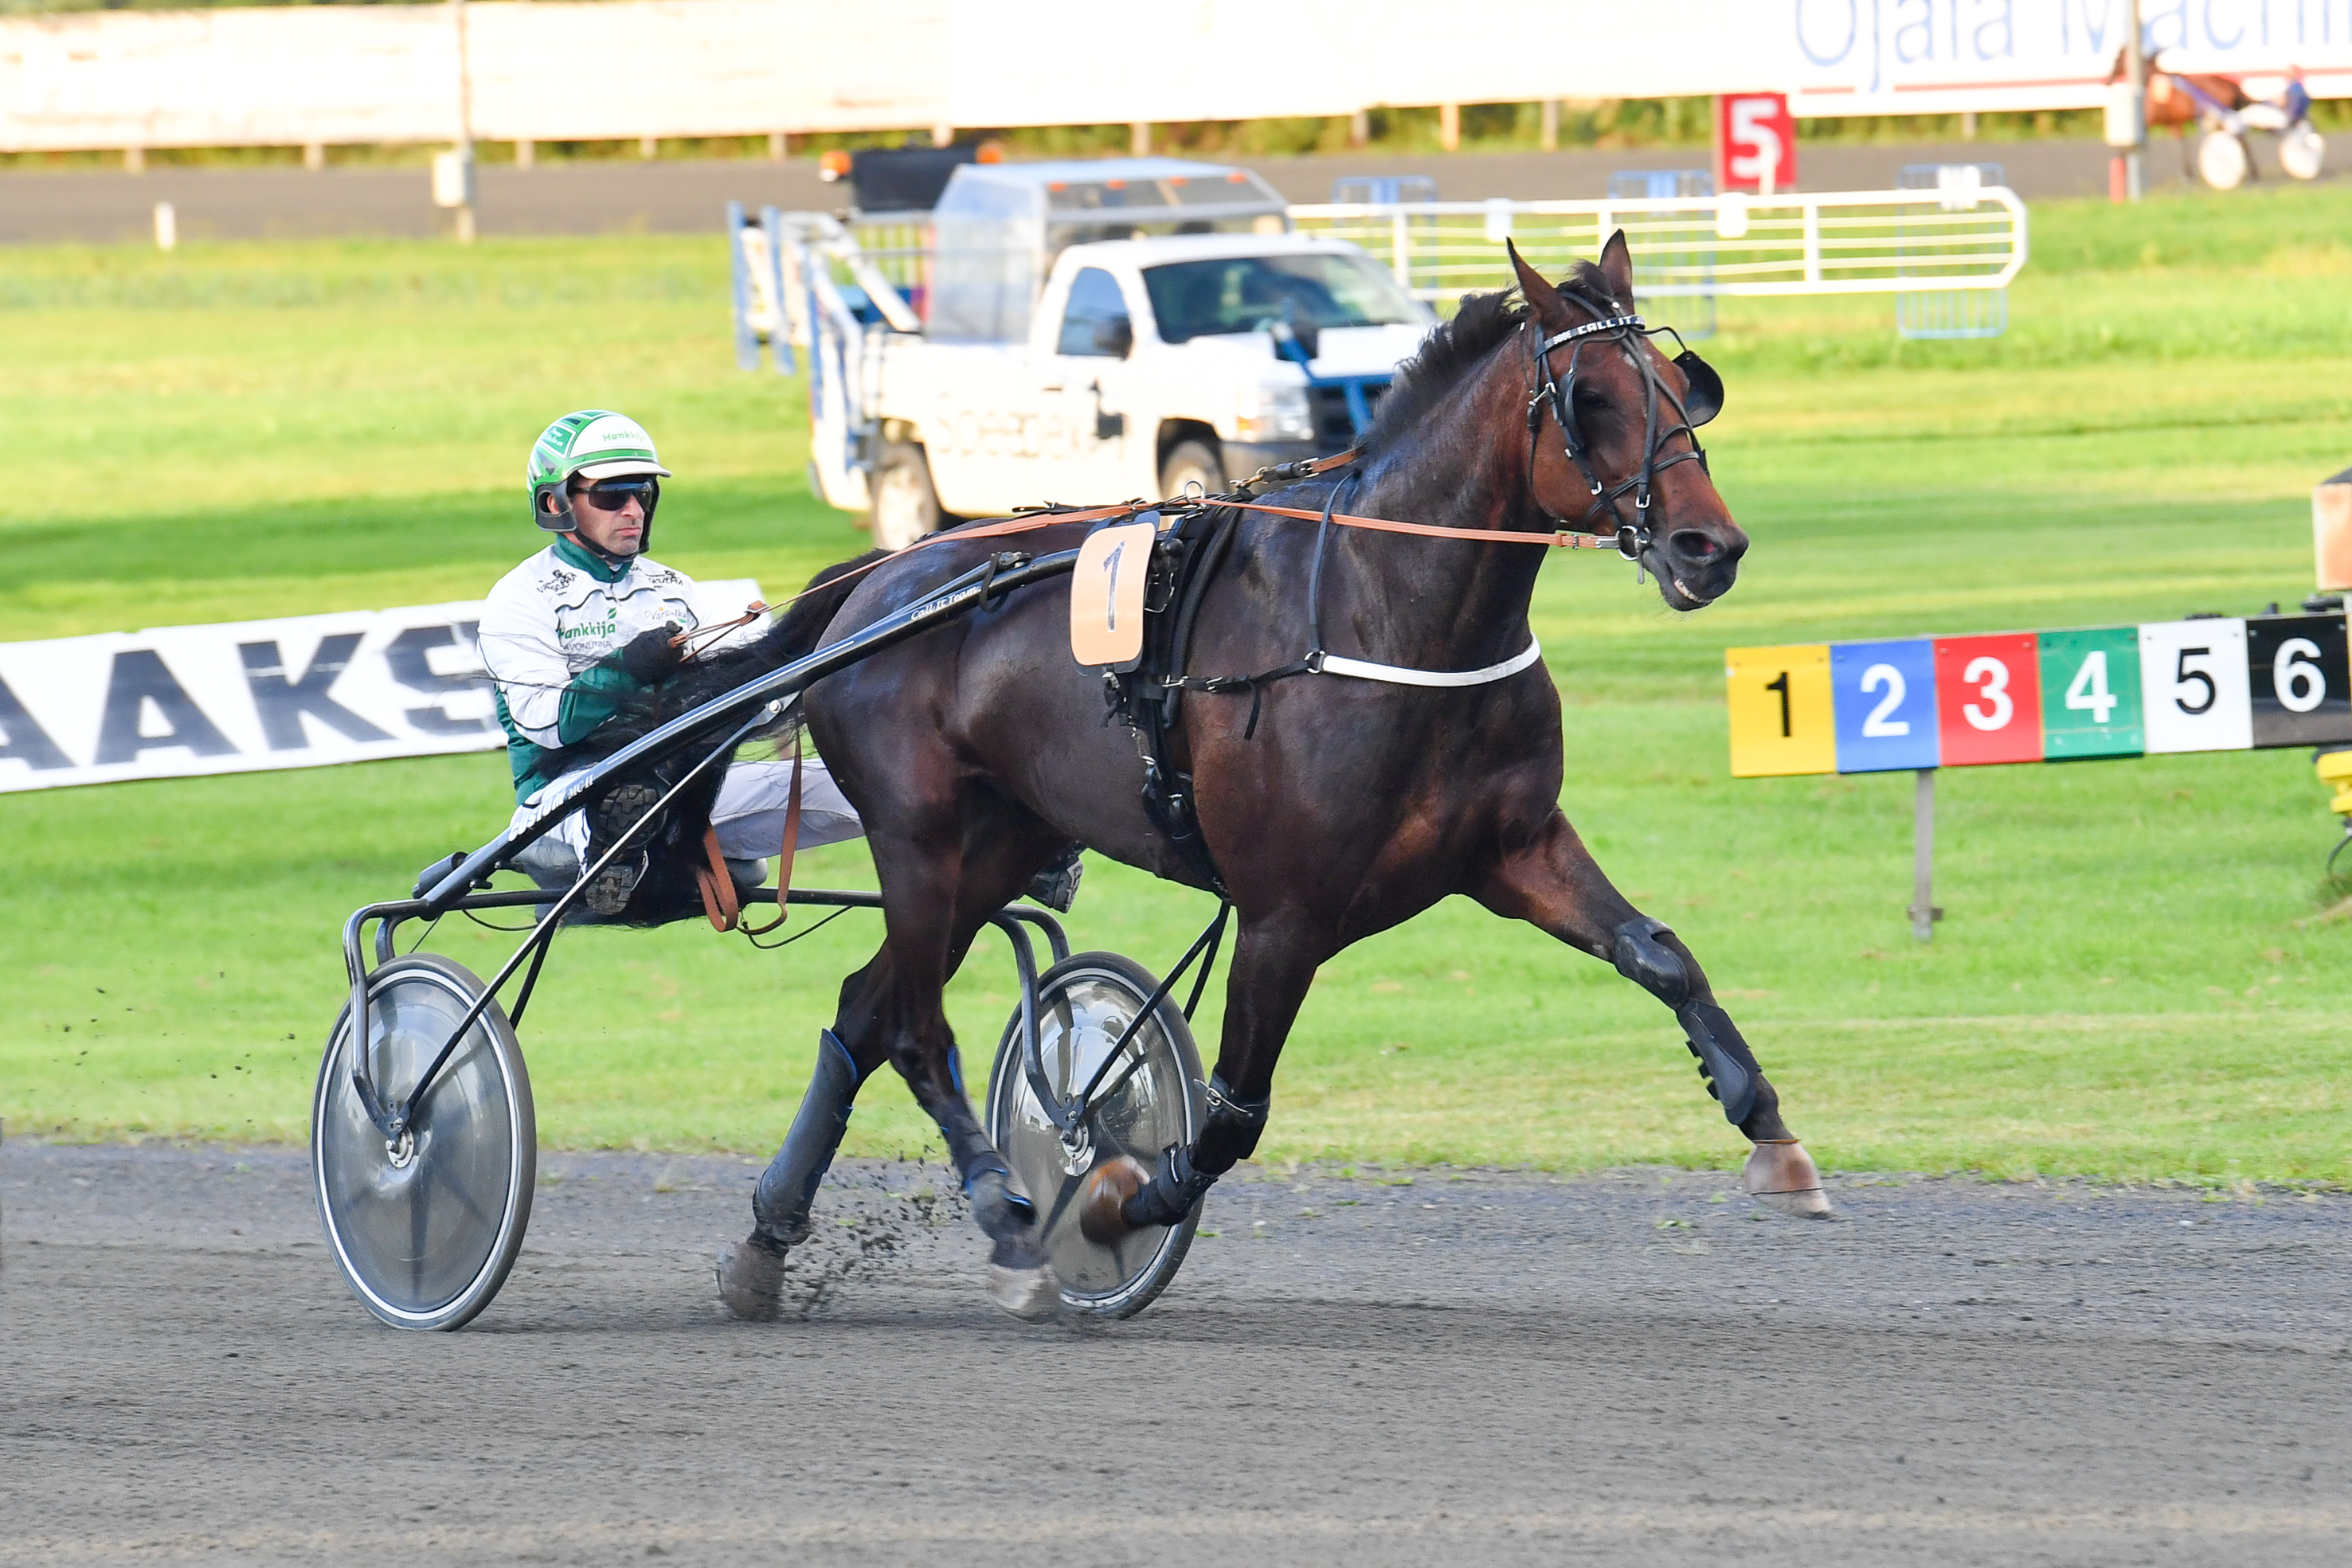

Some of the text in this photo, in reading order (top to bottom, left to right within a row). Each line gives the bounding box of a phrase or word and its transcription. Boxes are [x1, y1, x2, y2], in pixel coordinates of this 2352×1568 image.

[2064, 0, 2352, 56] Machi
[1730, 99, 1783, 179] 5
[1577, 316, 1633, 335] CALL IT
[910, 604, 936, 620] Call
[1104, 540, 1127, 633] 1
[1766, 637, 2327, 738] 1 2 3 4 5 6
